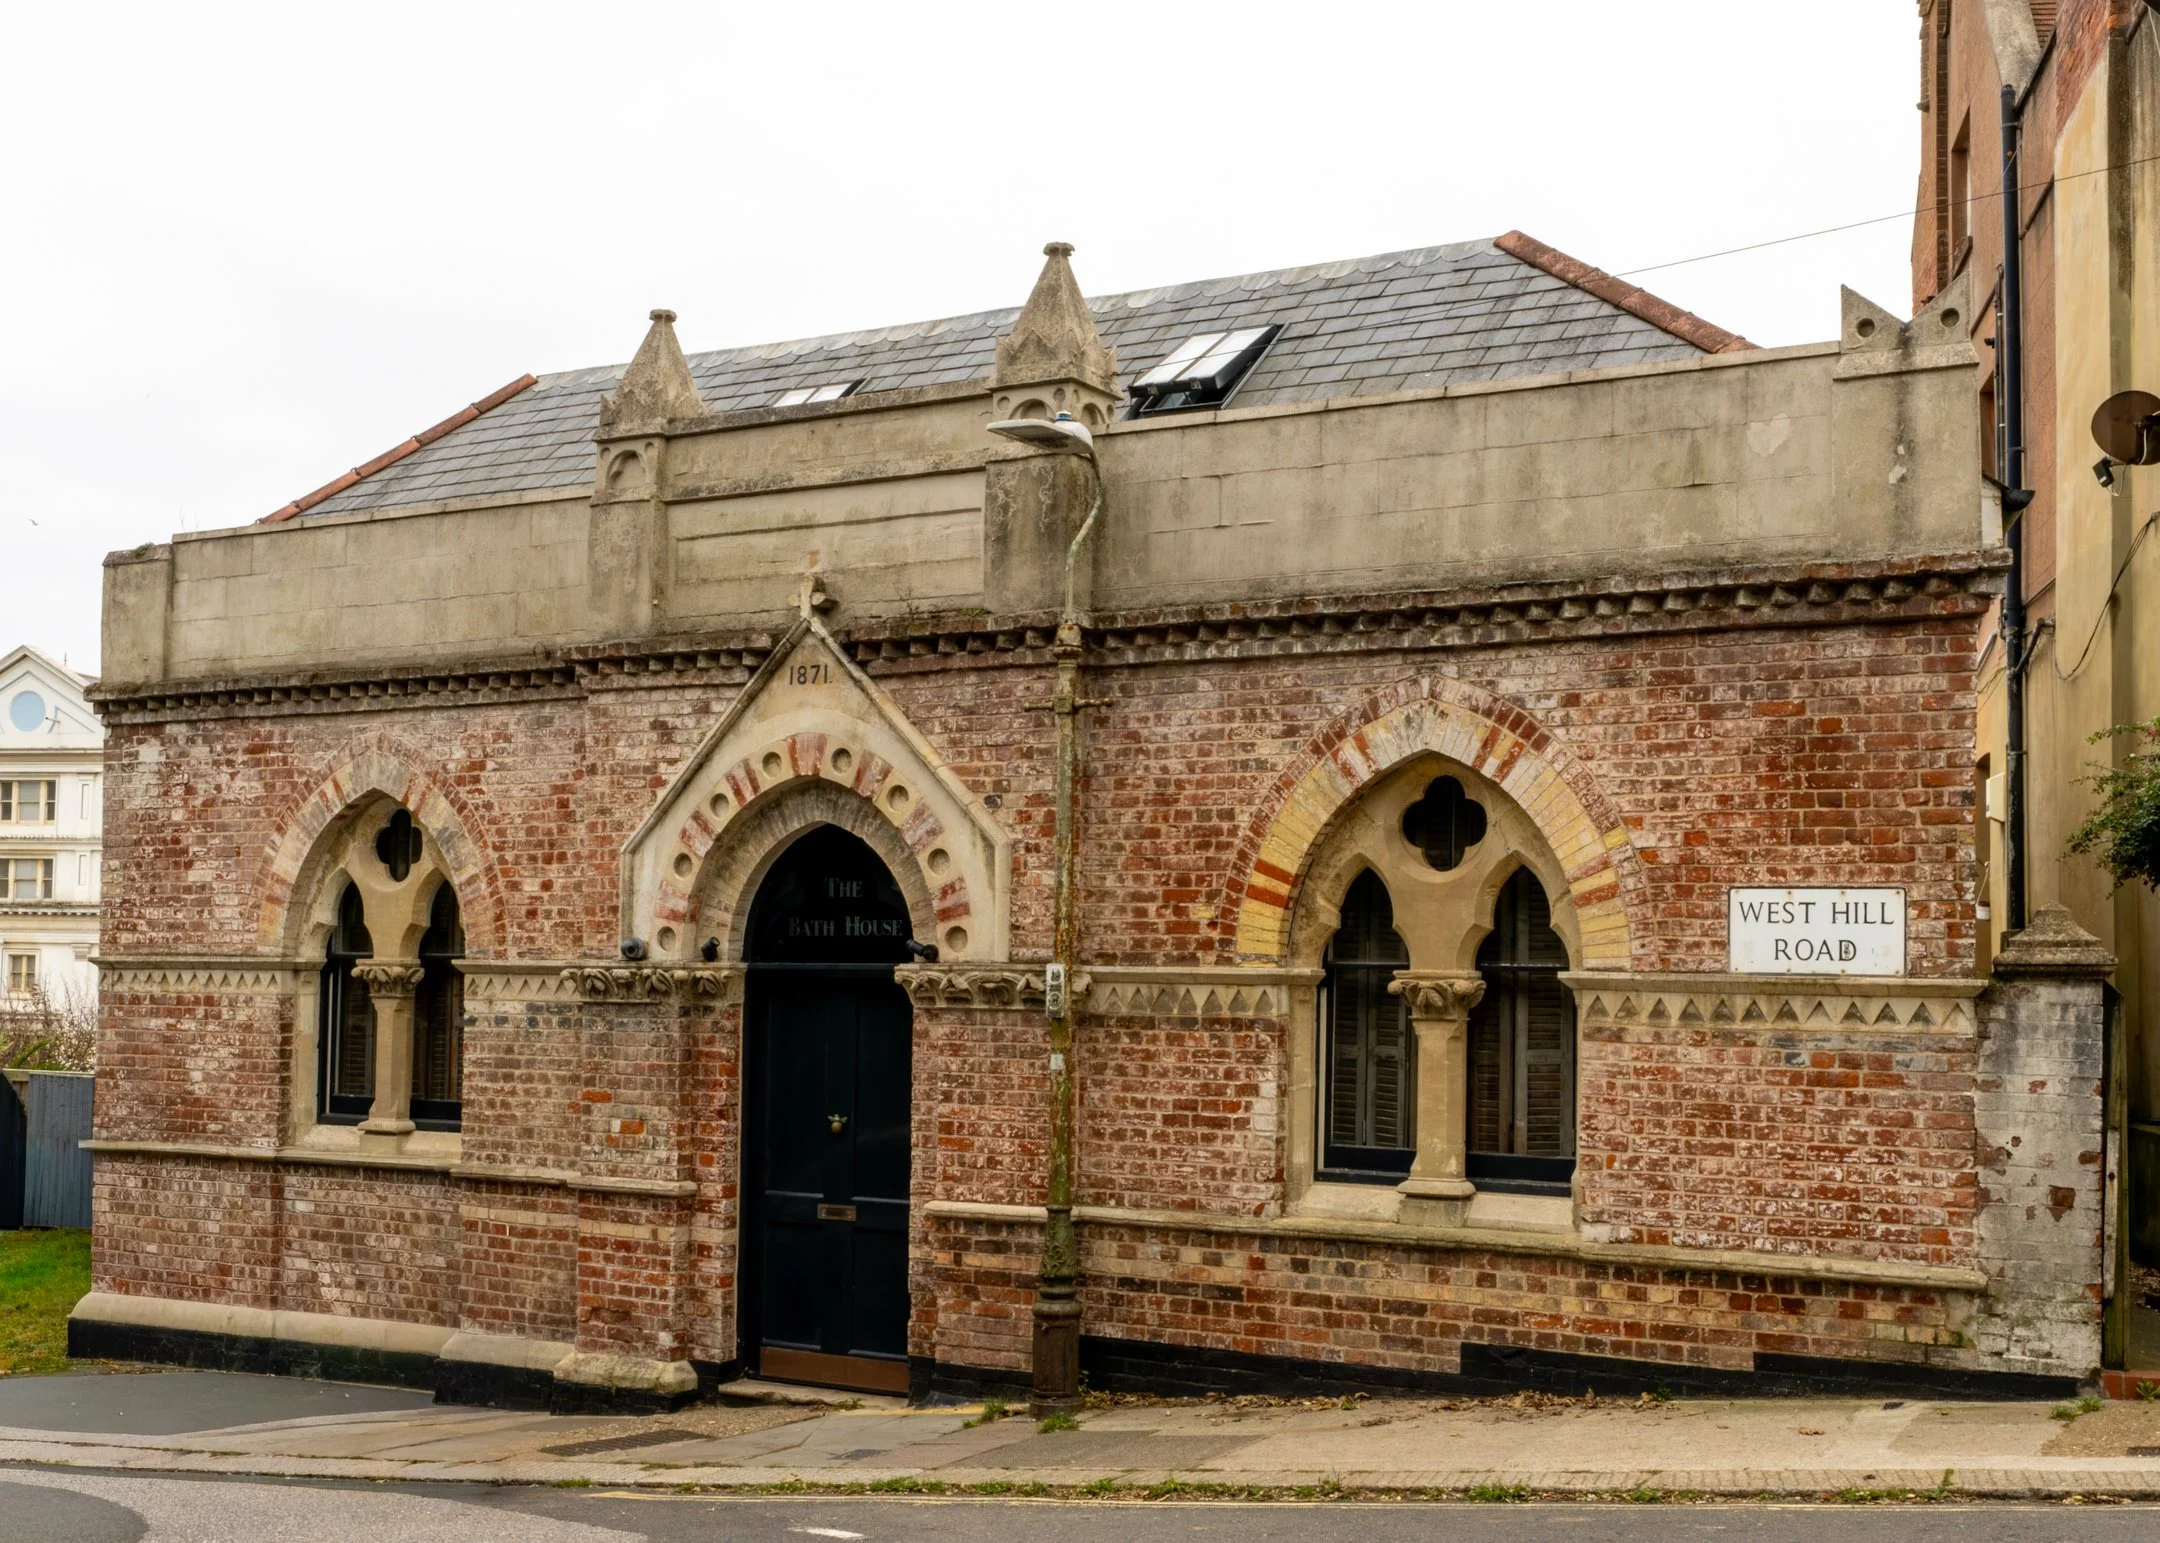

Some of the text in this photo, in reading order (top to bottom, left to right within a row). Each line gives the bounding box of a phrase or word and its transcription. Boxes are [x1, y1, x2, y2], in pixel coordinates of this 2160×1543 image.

[824, 877, 863, 898] THE
[1738, 901, 1894, 925] WEST HILL
[789, 916, 903, 936] BATH HOUSE
[1774, 938, 1857, 961] ROAD
